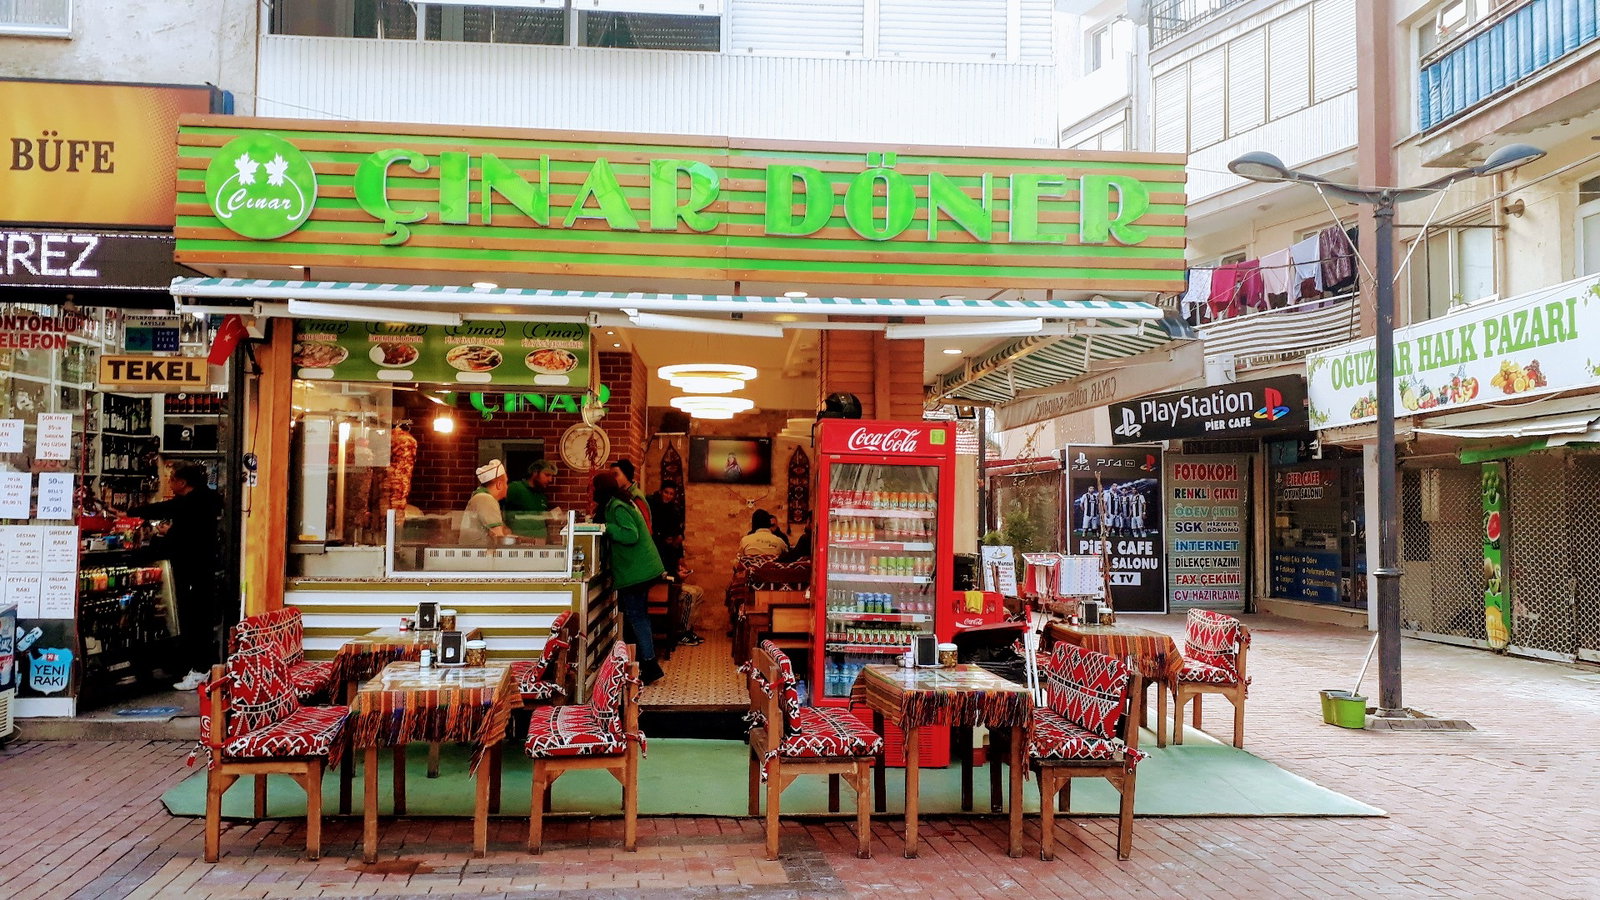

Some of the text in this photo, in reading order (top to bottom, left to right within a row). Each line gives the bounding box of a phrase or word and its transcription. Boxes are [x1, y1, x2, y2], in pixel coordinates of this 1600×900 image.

[10, 130, 115, 174] BÜFE
[354, 149, 1150, 246] ÇINAR DÖNER
[0, 234, 98, 277] REZ
[1416, 322, 1478, 372] HALK
[1482, 296, 1579, 358] PAZARI
[107, 360, 201, 382] TEKEL
[1141, 389, 1253, 427] PlayStation
[1229, 416, 1252, 428] CAFE
[848, 427, 921, 452] Coca-Cola
[1097, 458, 1122, 467] PS4
[1174, 462, 1238, 482] FOTOKOPİ
[1174, 486, 1238, 502] RENKLİ ÇIKTI
[1175, 503, 1209, 518] ÖDEV
[1175, 521, 1203, 534] SGK
[1117, 540, 1153, 555] CAFE
[1175, 539, 1240, 552] İNTERNET
[1112, 557, 1158, 570] SALONU
[1175, 555, 1240, 570] DİLEKÇE YAZIMI
[1120, 574, 1134, 583] TV
[1175, 572, 1241, 587] FAX ÇEKİMİ
[1174, 590, 1240, 601] CV HAZIRLAMA
[34, 676, 63, 686] RAKI
